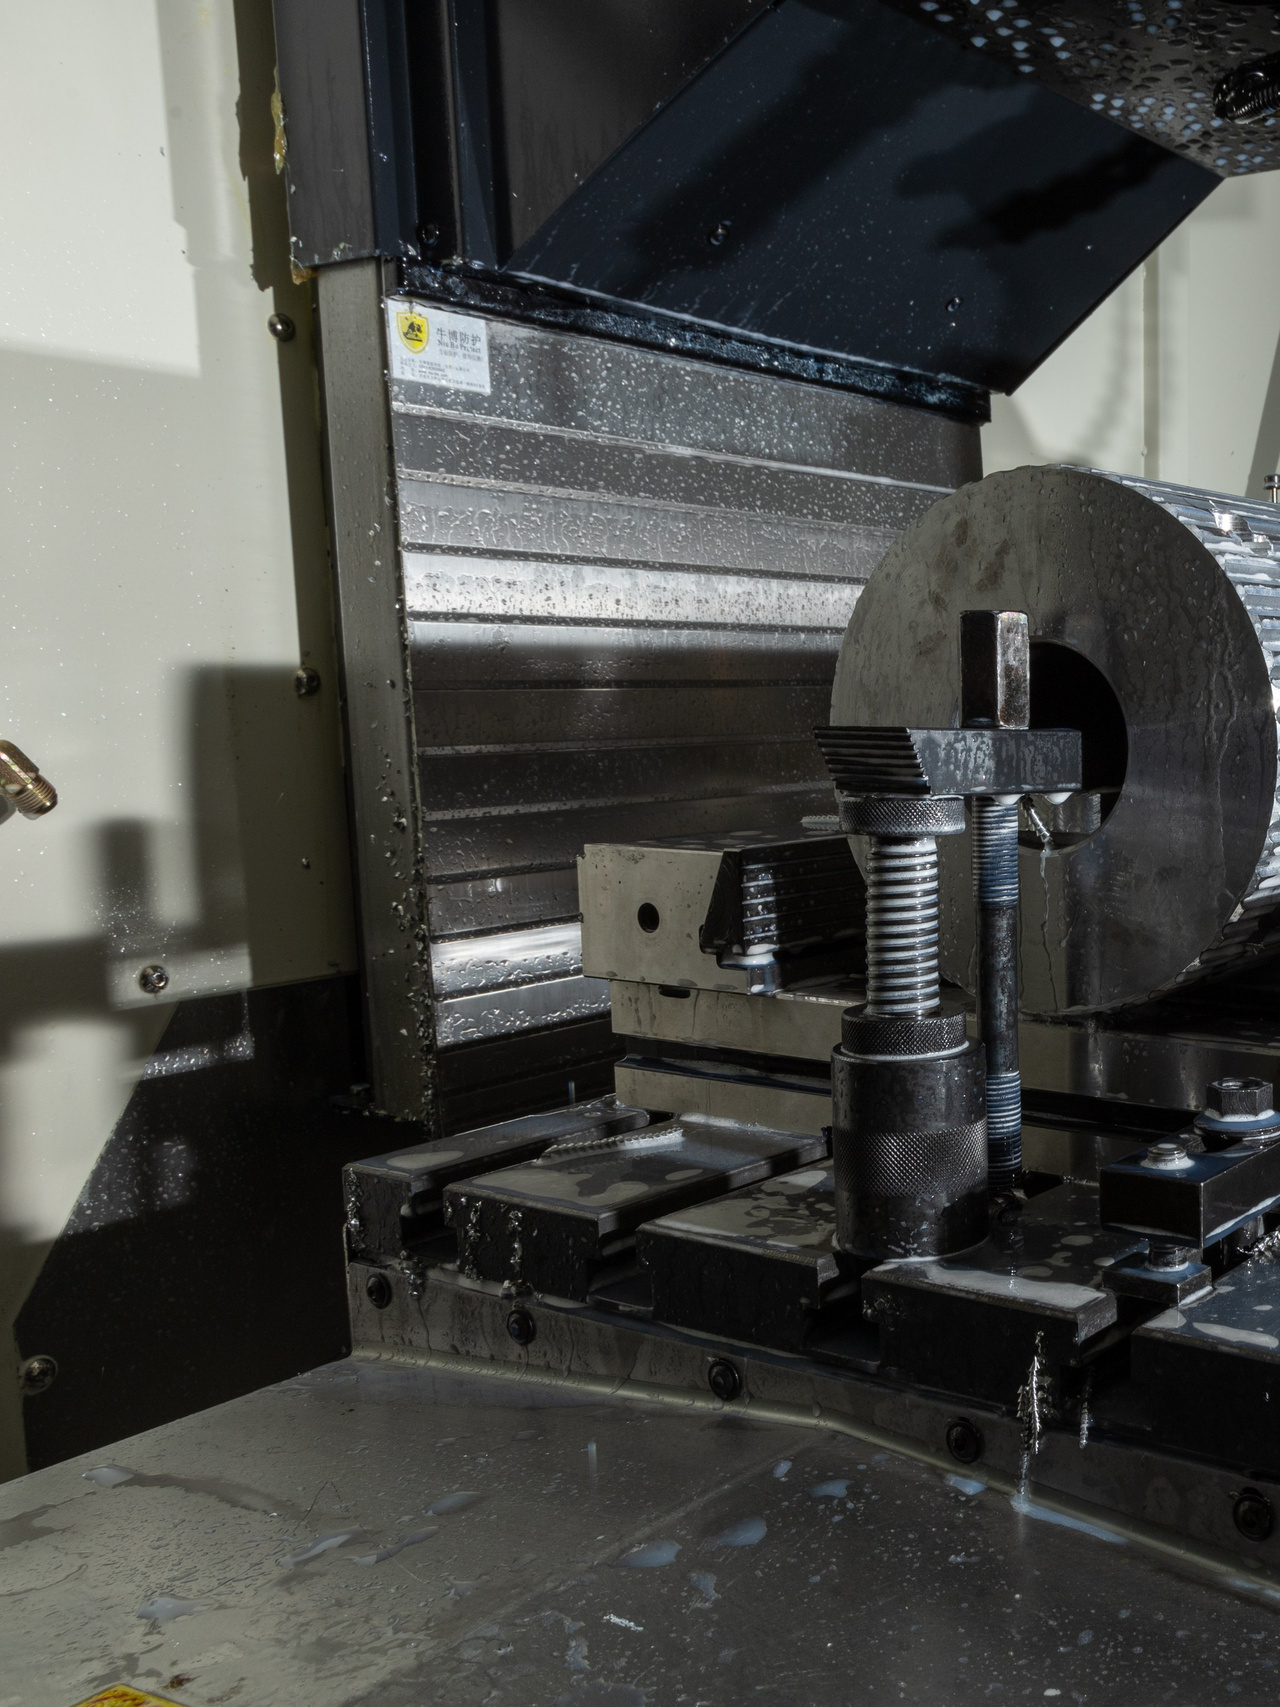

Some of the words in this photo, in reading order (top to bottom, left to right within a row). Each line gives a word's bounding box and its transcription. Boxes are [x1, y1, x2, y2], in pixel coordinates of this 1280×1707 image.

[436, 327, 482, 346] 牛博防护
[450, 342, 459, 350] Bo
